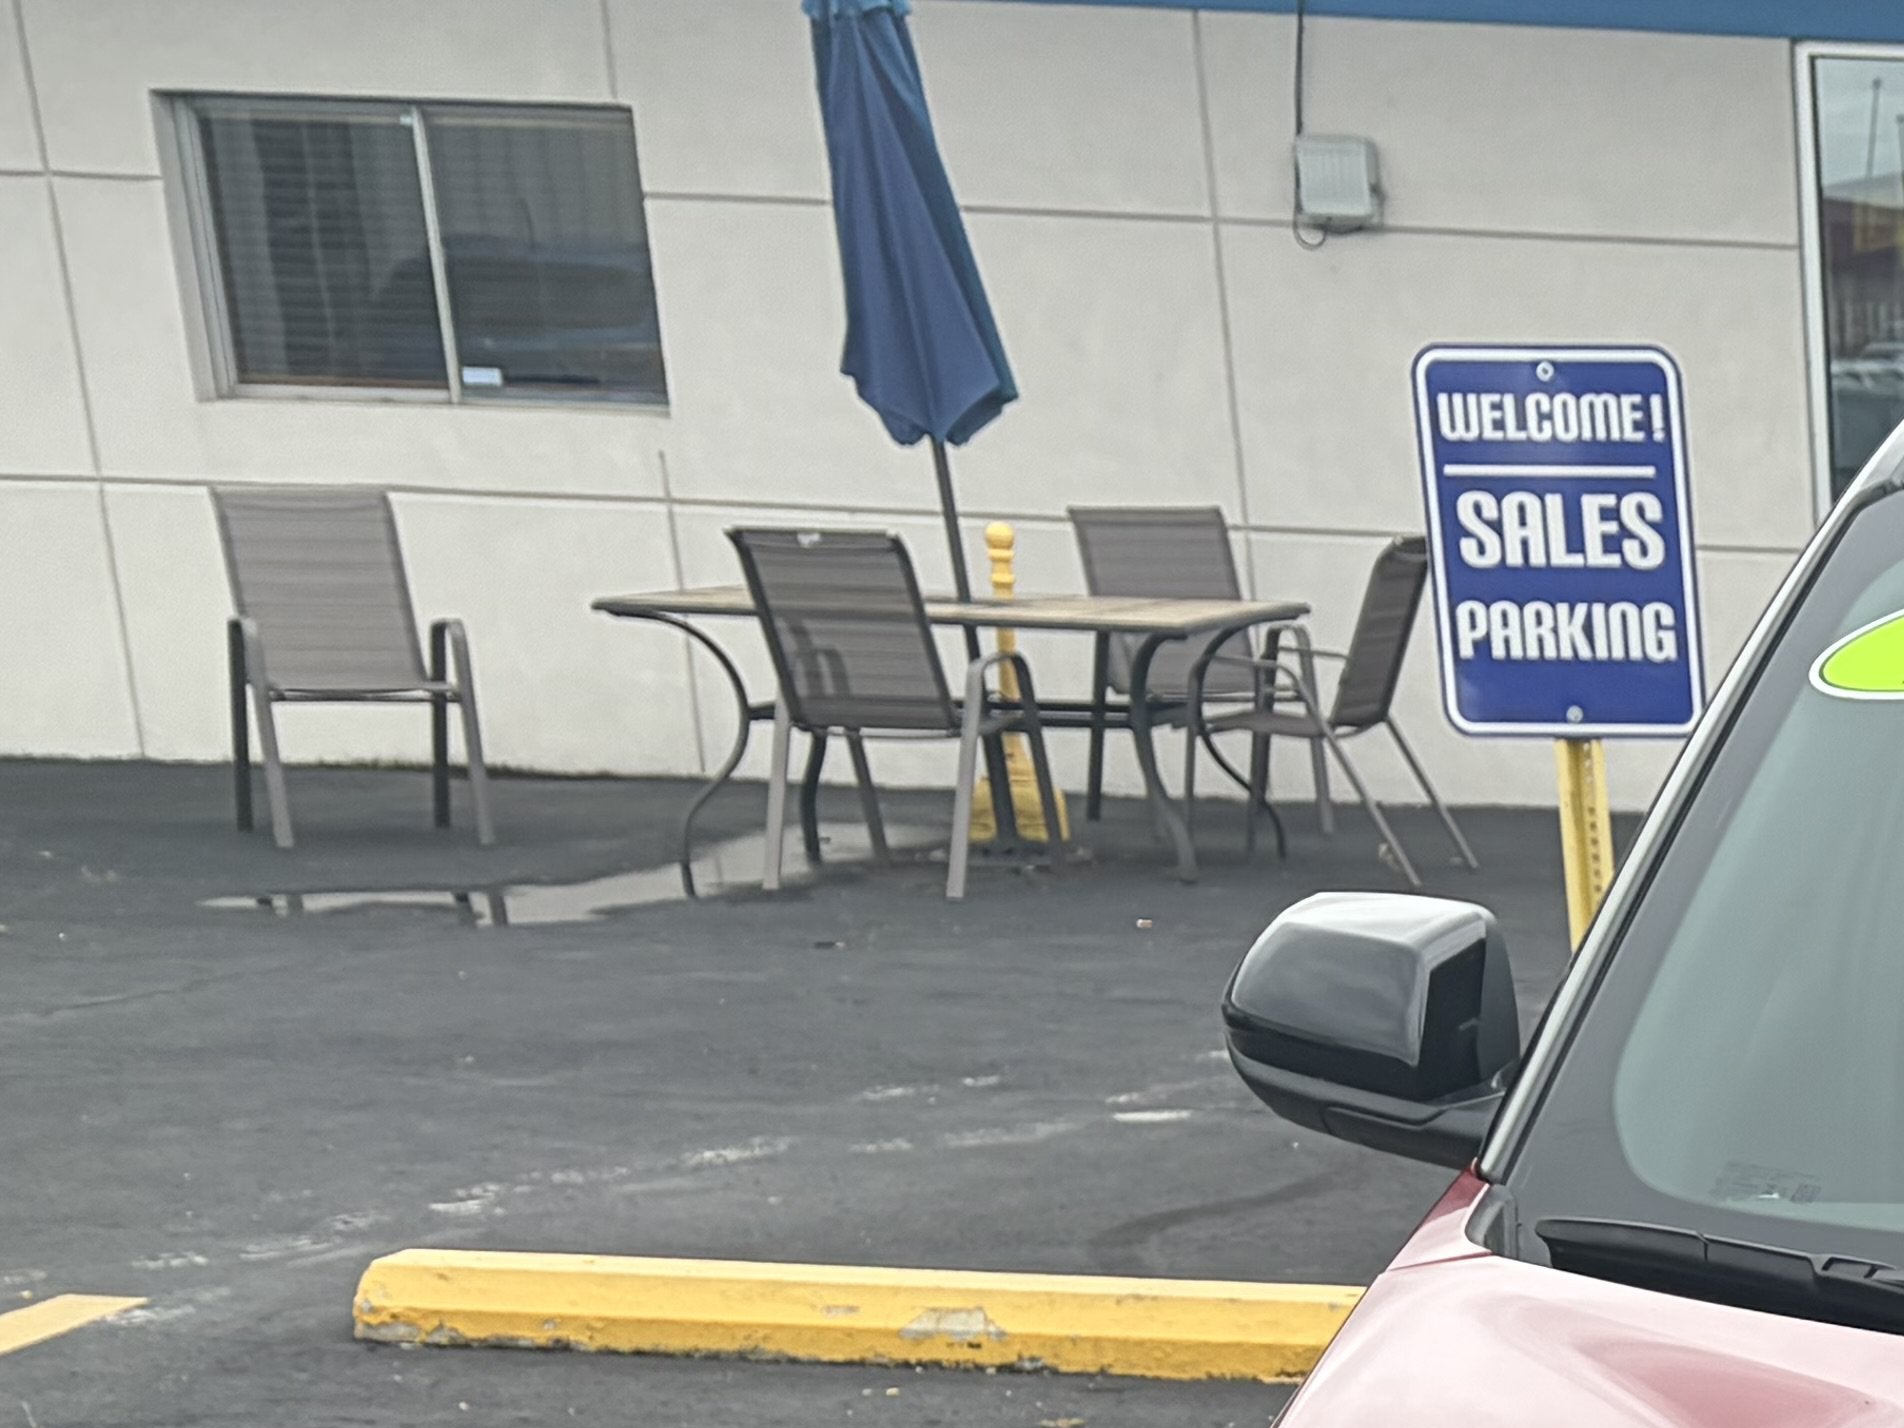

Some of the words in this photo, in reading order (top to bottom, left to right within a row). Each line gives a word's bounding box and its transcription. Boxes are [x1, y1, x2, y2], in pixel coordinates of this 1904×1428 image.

[1437, 392, 1665, 442] WELCOME!
[1456, 490, 1666, 570] SALES
[1455, 600, 1678, 662] PARKING
